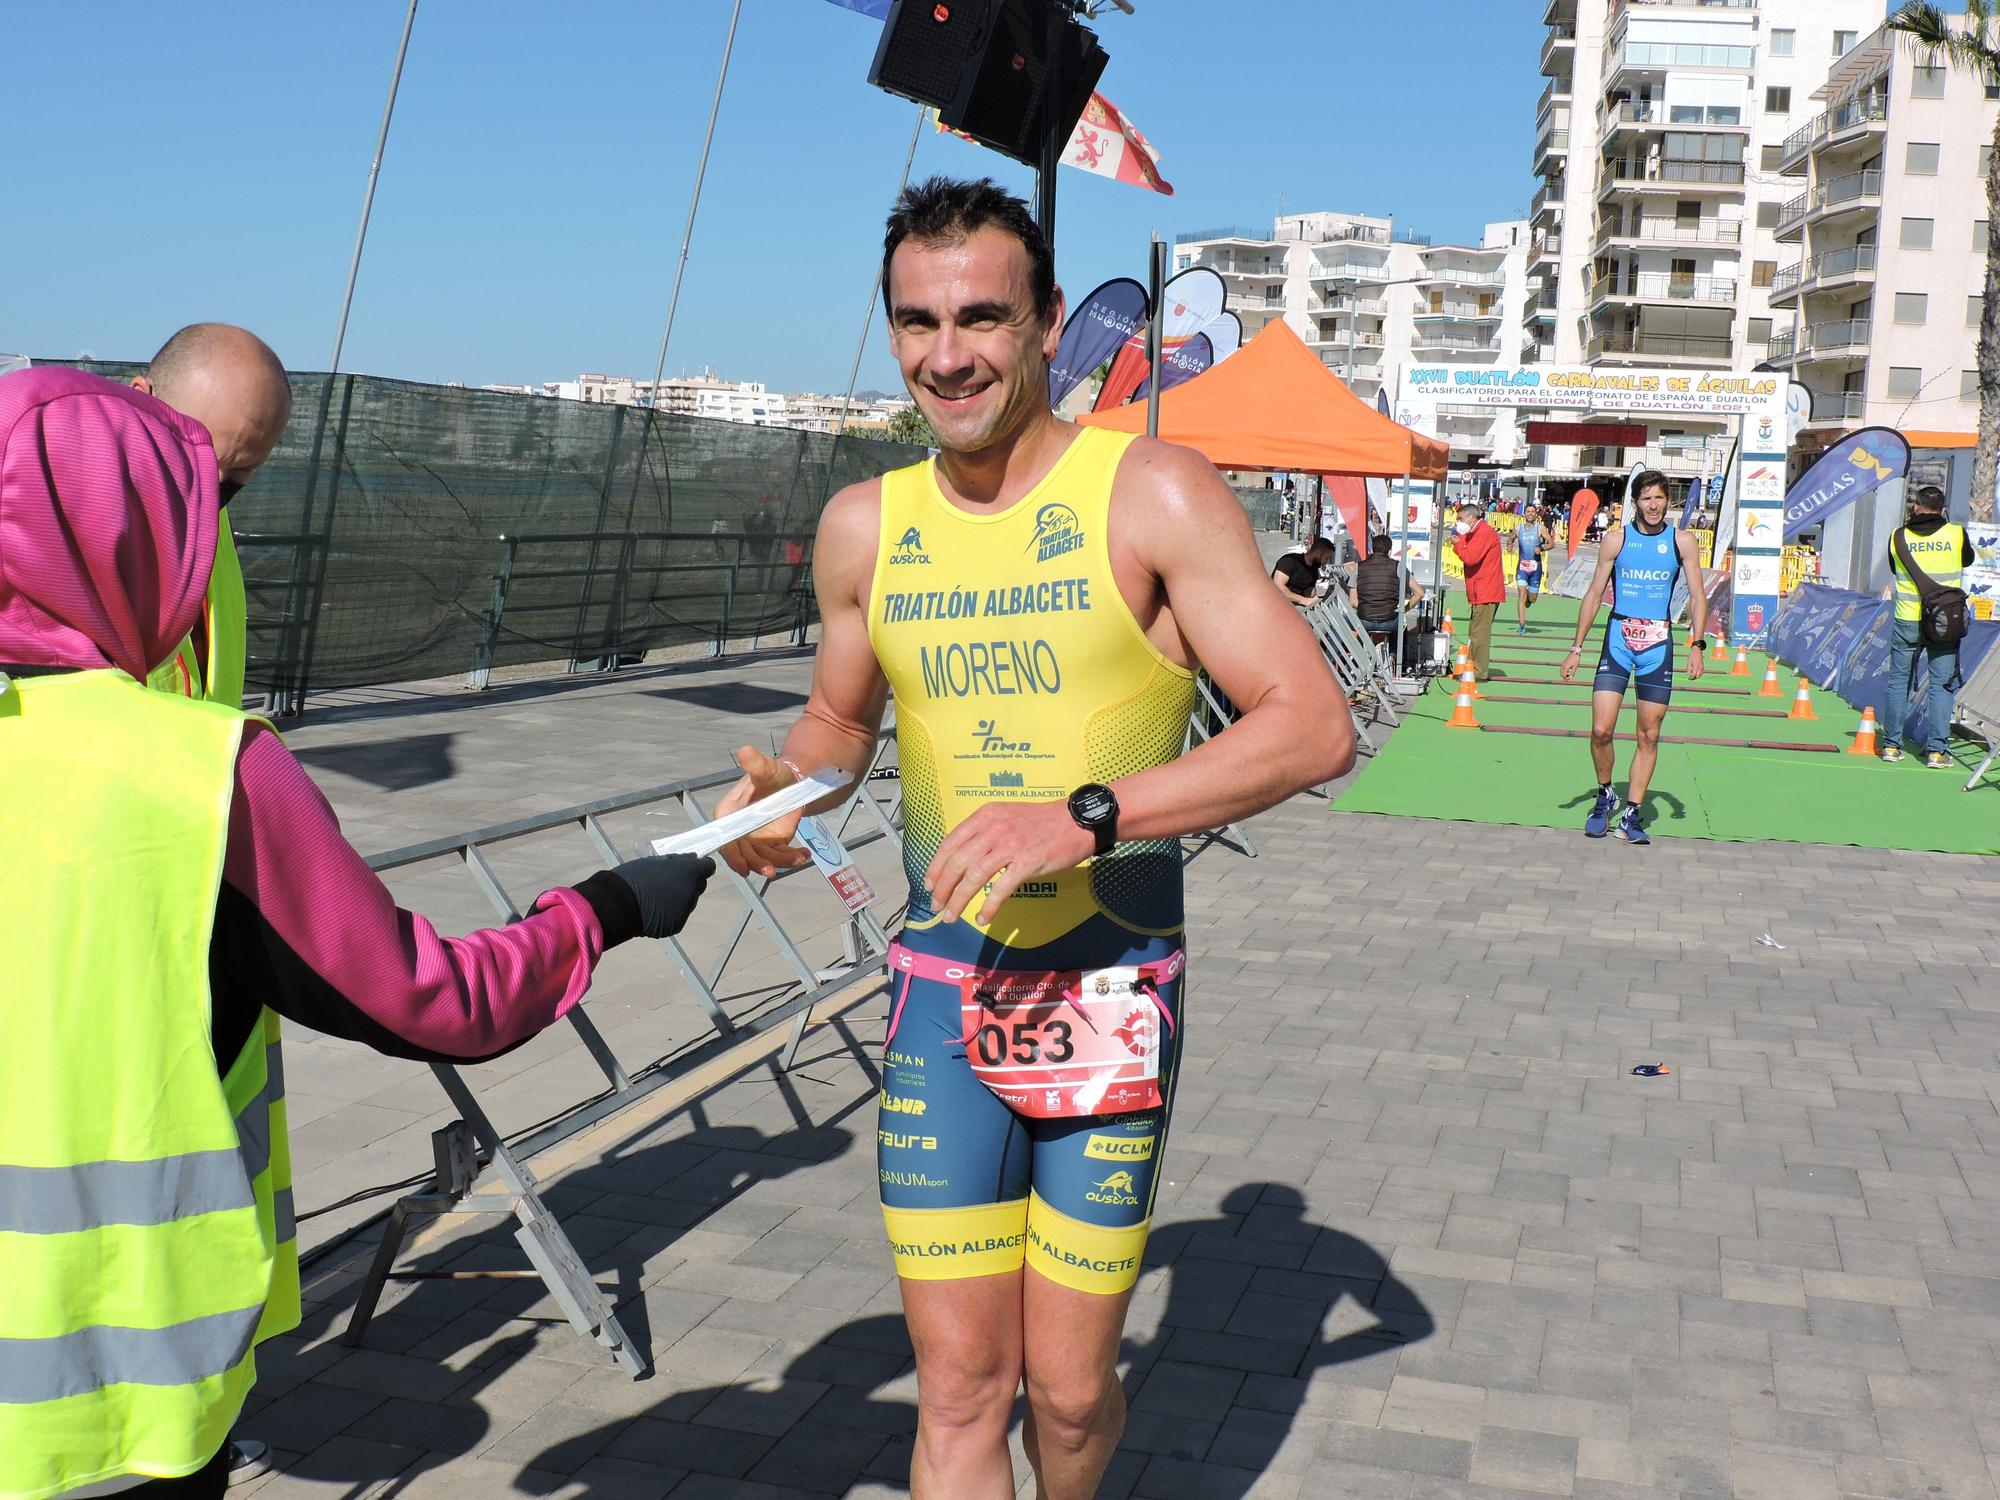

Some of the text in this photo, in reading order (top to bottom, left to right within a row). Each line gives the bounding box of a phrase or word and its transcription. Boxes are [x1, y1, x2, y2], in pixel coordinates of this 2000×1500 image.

[1089, 309, 1132, 335] MURCIA
[1174, 352, 1204, 368] EGIÓN
[1409, 367, 1776, 395] XXVII DUATLÓN CARNAVALES DE ÁGUILAS
[1418, 387, 1505, 396] CLASIFICATORIO
[1652, 392, 1695, 402] ESPAÑA
[1716, 394, 1767, 404] DUATLÓN
[1518, 397, 1598, 406] REGIONAL
[1635, 400, 1704, 409] DUATLÓN
[1037, 532, 1084, 563] ALBACETE
[1908, 541, 1952, 552] RENSA
[883, 578, 1091, 624] TRIATLÓN ALBACETE
[920, 638, 1061, 699] MORENO
[956, 788, 1066, 798] DIPUTACIÓN DE ALBACETE
[973, 982, 1035, 994] Clasificatorio
[1058, 981, 1070, 989] de
[1010, 991, 1046, 1001] Duatlón
[978, 1020, 1075, 1066] 053
[1105, 1142, 1152, 1155] UCLM
[1085, 1191, 1139, 1206] austral
[1042, 1241, 1136, 1273] ALBACETE
